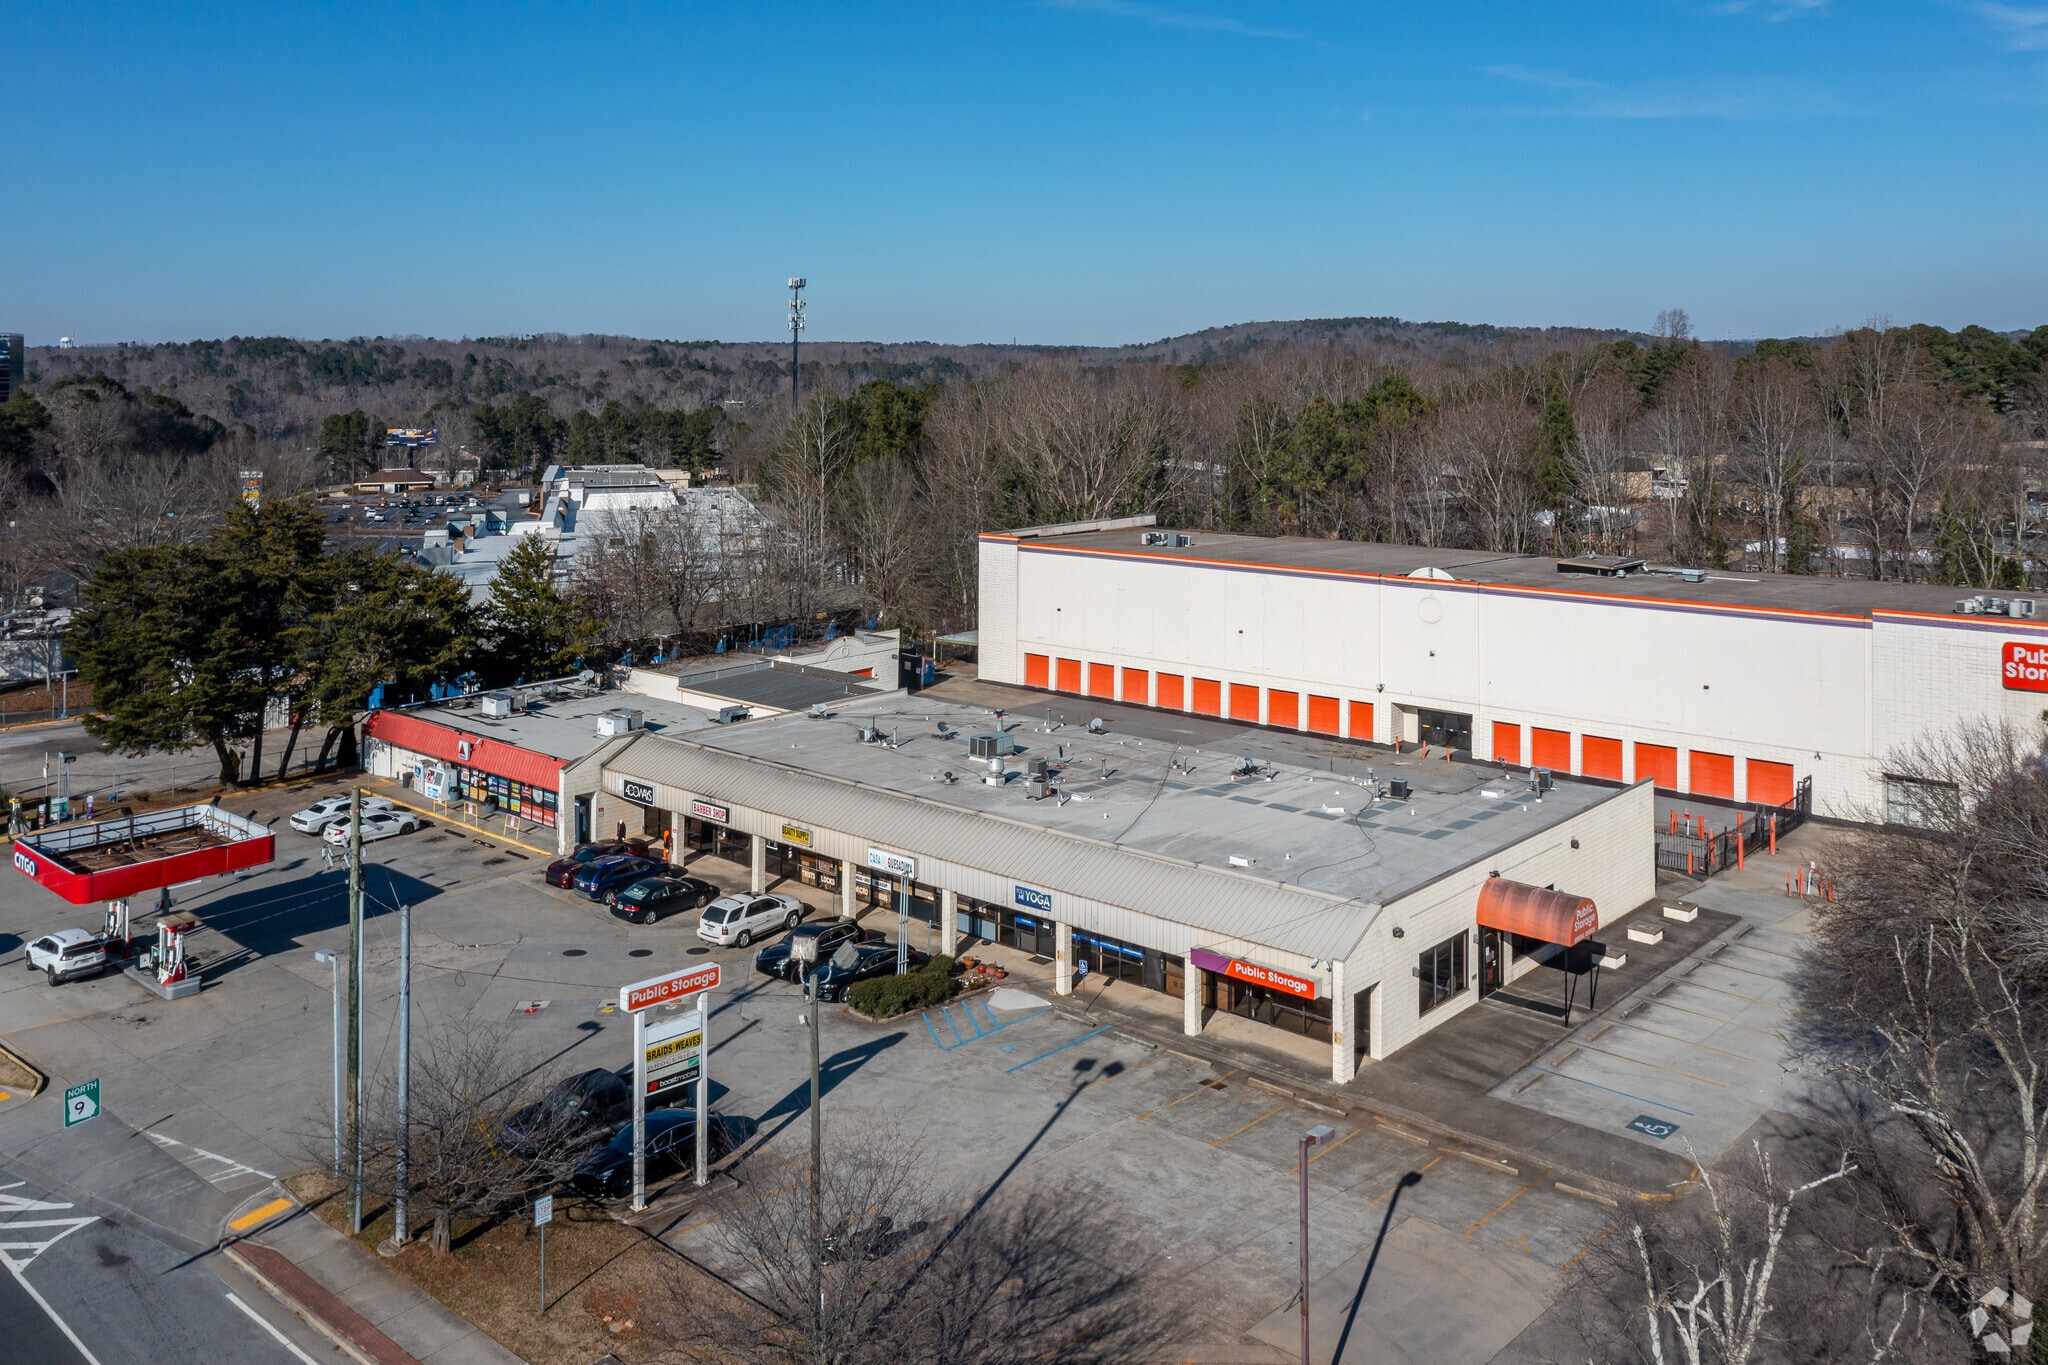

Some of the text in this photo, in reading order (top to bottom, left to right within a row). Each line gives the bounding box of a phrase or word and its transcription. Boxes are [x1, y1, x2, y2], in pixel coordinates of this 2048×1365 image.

[2013, 646, 2048, 665] Pub
[2005, 661, 2048, 681] Stor
[693, 802, 725, 820] BARBER SHOP
[782, 825, 809, 841] BEAUTY SUPPLY
[14, 852, 36, 877] CITGO
[820, 875, 836, 887] LOCKS
[1025, 890, 1050, 907] YOGA
[1576, 903, 1593, 921] Public
[1574, 913, 1595, 932] Storage
[631, 970, 716, 1004] Public Storage
[1235, 963, 1308, 993] Public Storage
[646, 1043, 673, 1061] BRAIDS
[675, 1034, 701, 1051] WEAVES
[647, 1050, 697, 1071] GROCERIES
[67, 1081, 97, 1098] NORTH
[74, 1101, 85, 1115] 9
